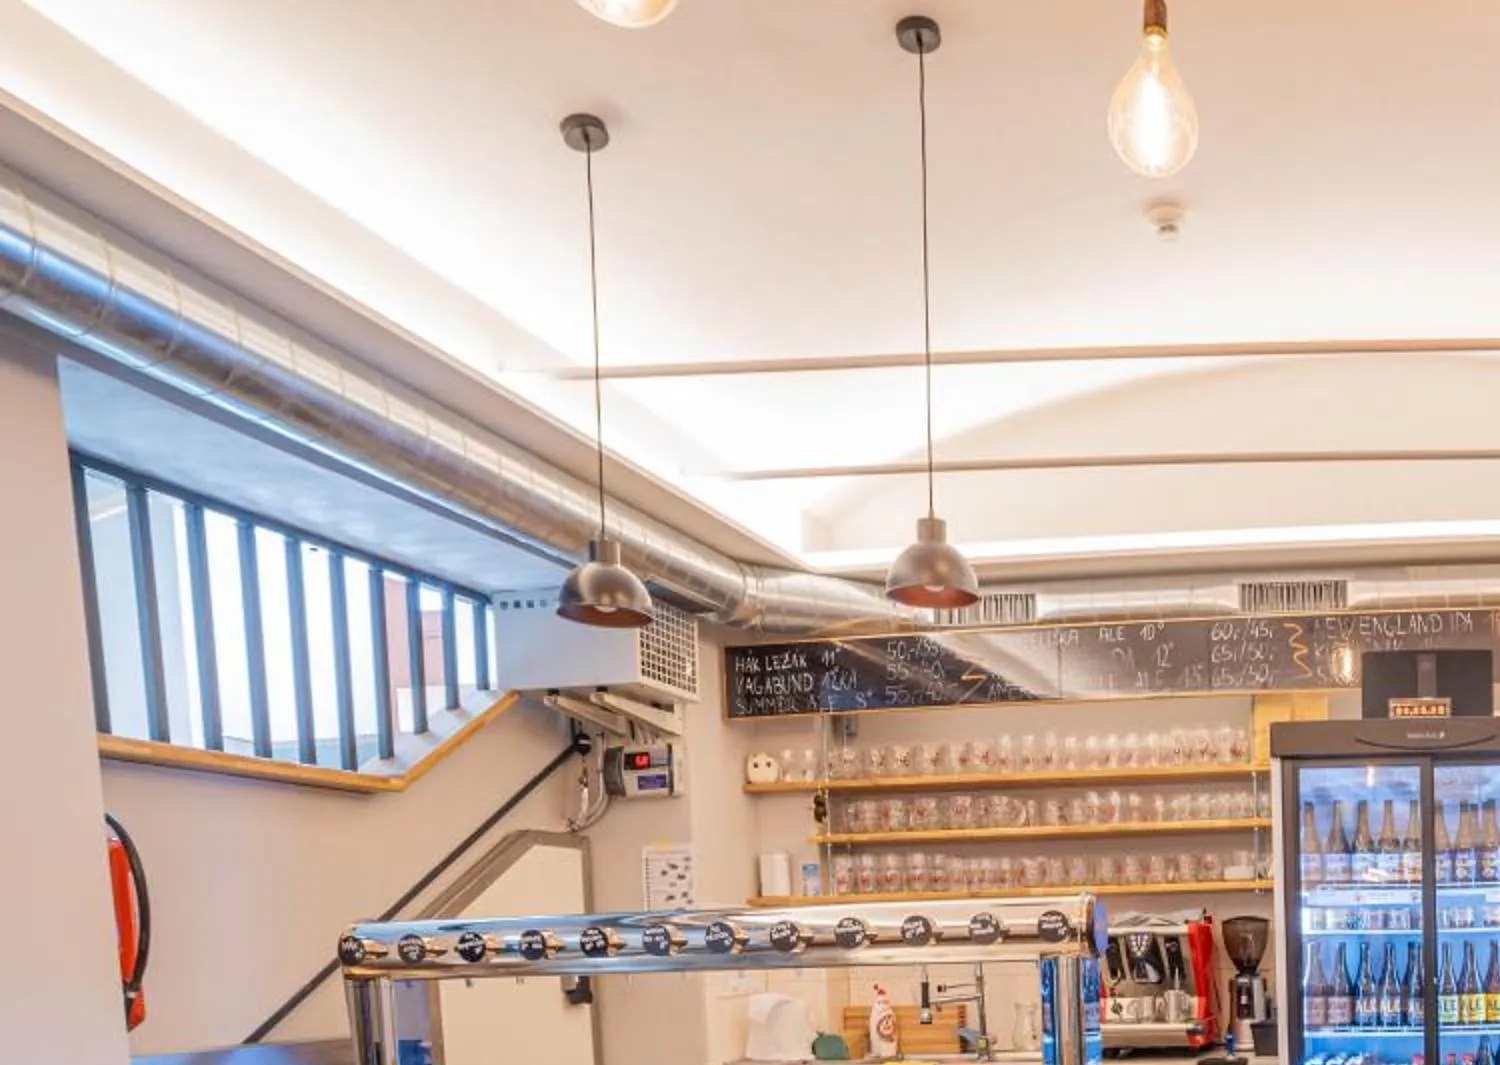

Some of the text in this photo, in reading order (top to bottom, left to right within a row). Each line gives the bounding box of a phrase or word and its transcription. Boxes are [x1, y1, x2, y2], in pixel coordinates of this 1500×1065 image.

[1099, 626, 1127, 642] ALE
[1359, 612, 1444, 637] ENGLAND
[1450, 611, 1474, 633] IPA
[735, 649, 761, 673] HÁK
[736, 672, 815, 696] VAGABUND
